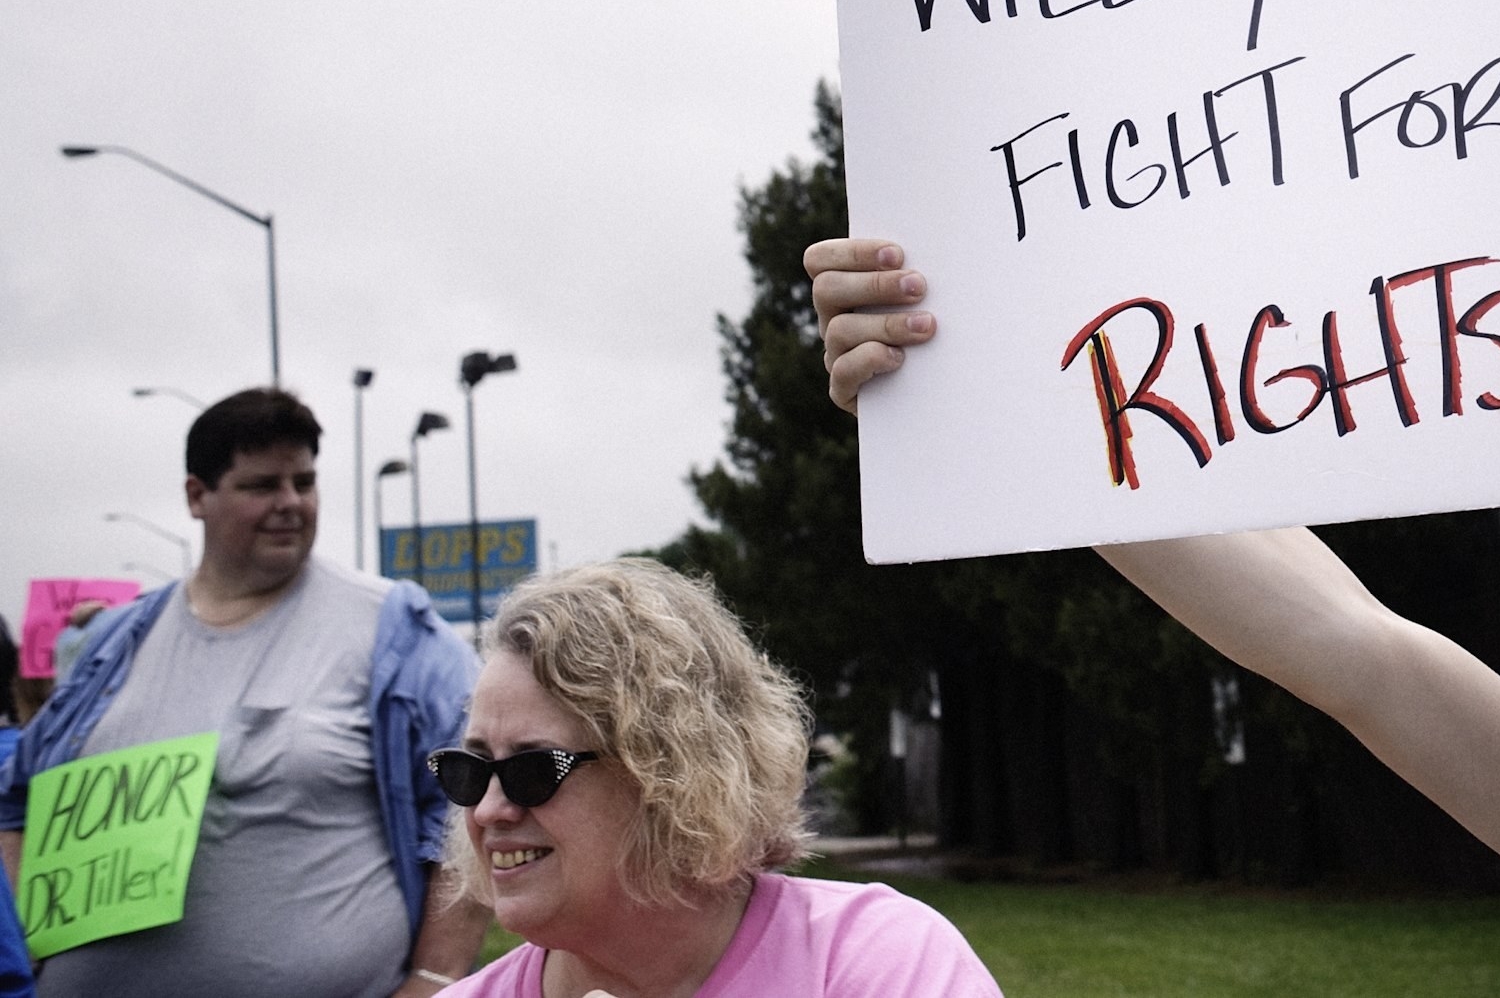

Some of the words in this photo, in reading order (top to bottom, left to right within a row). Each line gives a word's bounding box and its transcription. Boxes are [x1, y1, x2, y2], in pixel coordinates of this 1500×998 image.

[990, 56, 1307, 243] FIGHT
[37, 752, 200, 857] HONOR
[24, 867, 76, 940] DR
[78, 828, 185, 917] Tiller!
